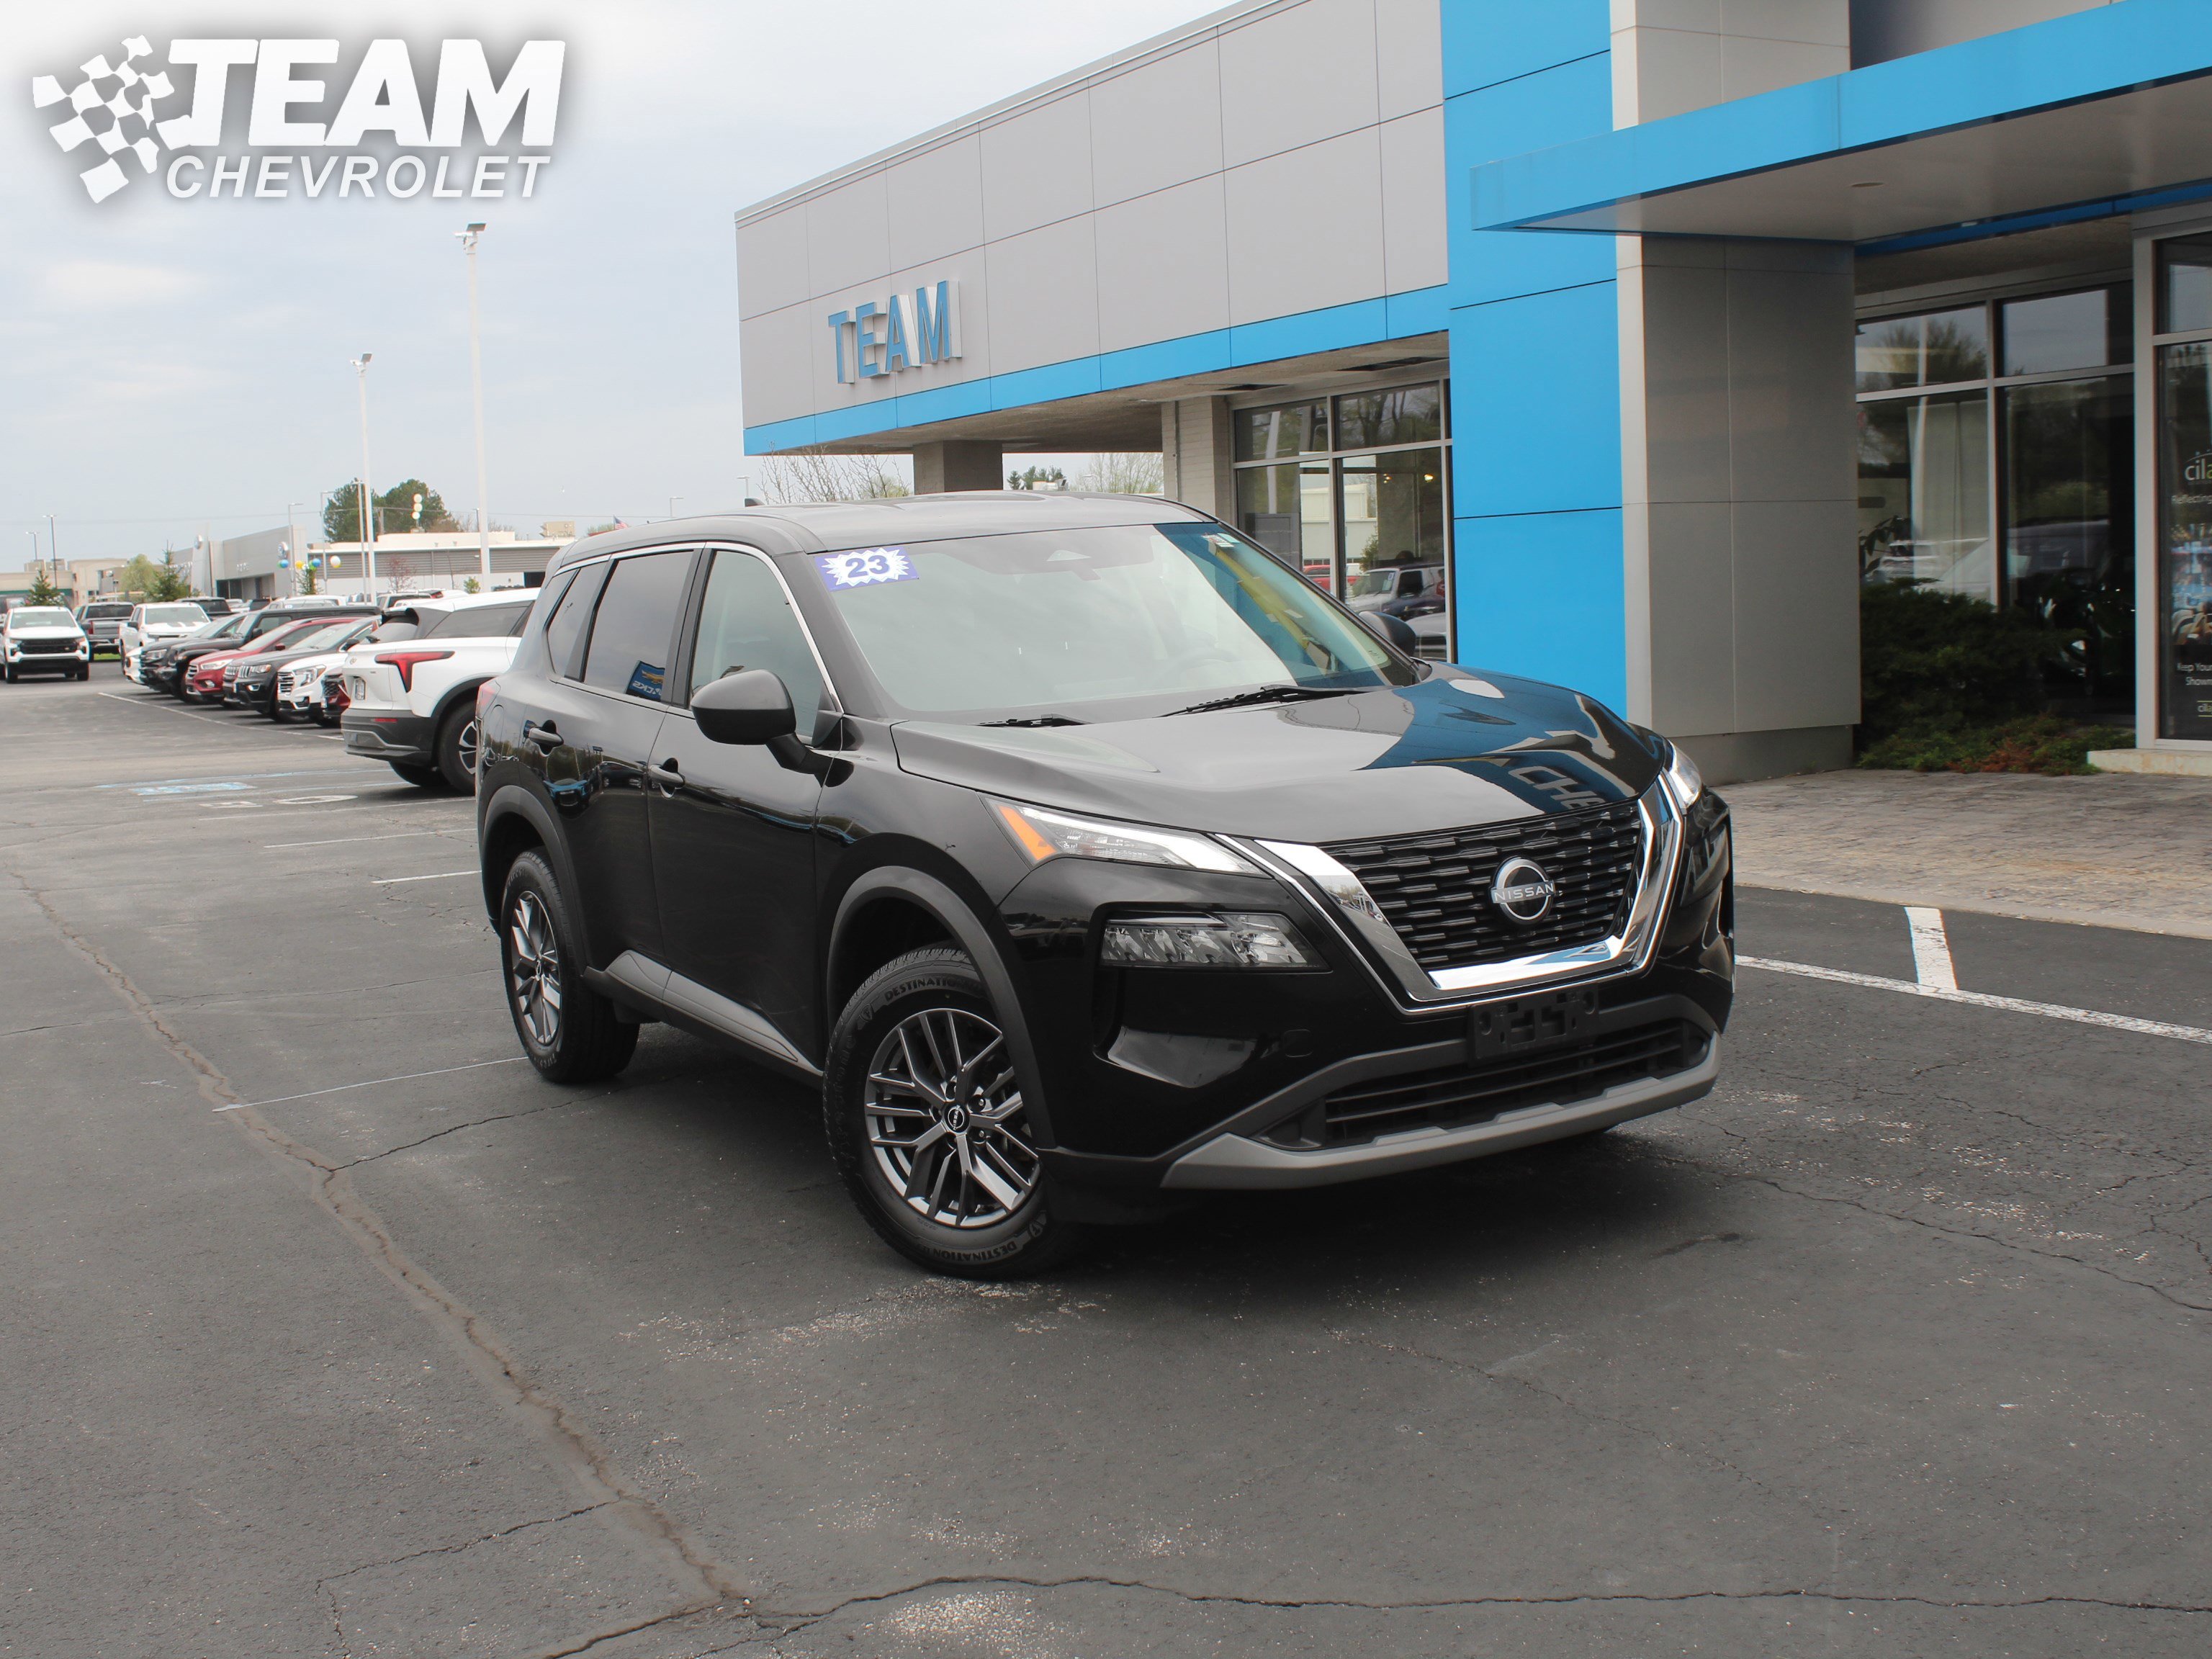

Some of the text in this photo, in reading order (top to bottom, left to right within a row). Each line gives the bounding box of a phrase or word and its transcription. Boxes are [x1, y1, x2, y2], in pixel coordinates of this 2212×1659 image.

[828, 280, 962, 385] TEAM
[845, 554, 890, 578] 23
[1494, 883, 1554, 902] NISSAN
[933, 1241, 1017, 1262] DESTINATION
